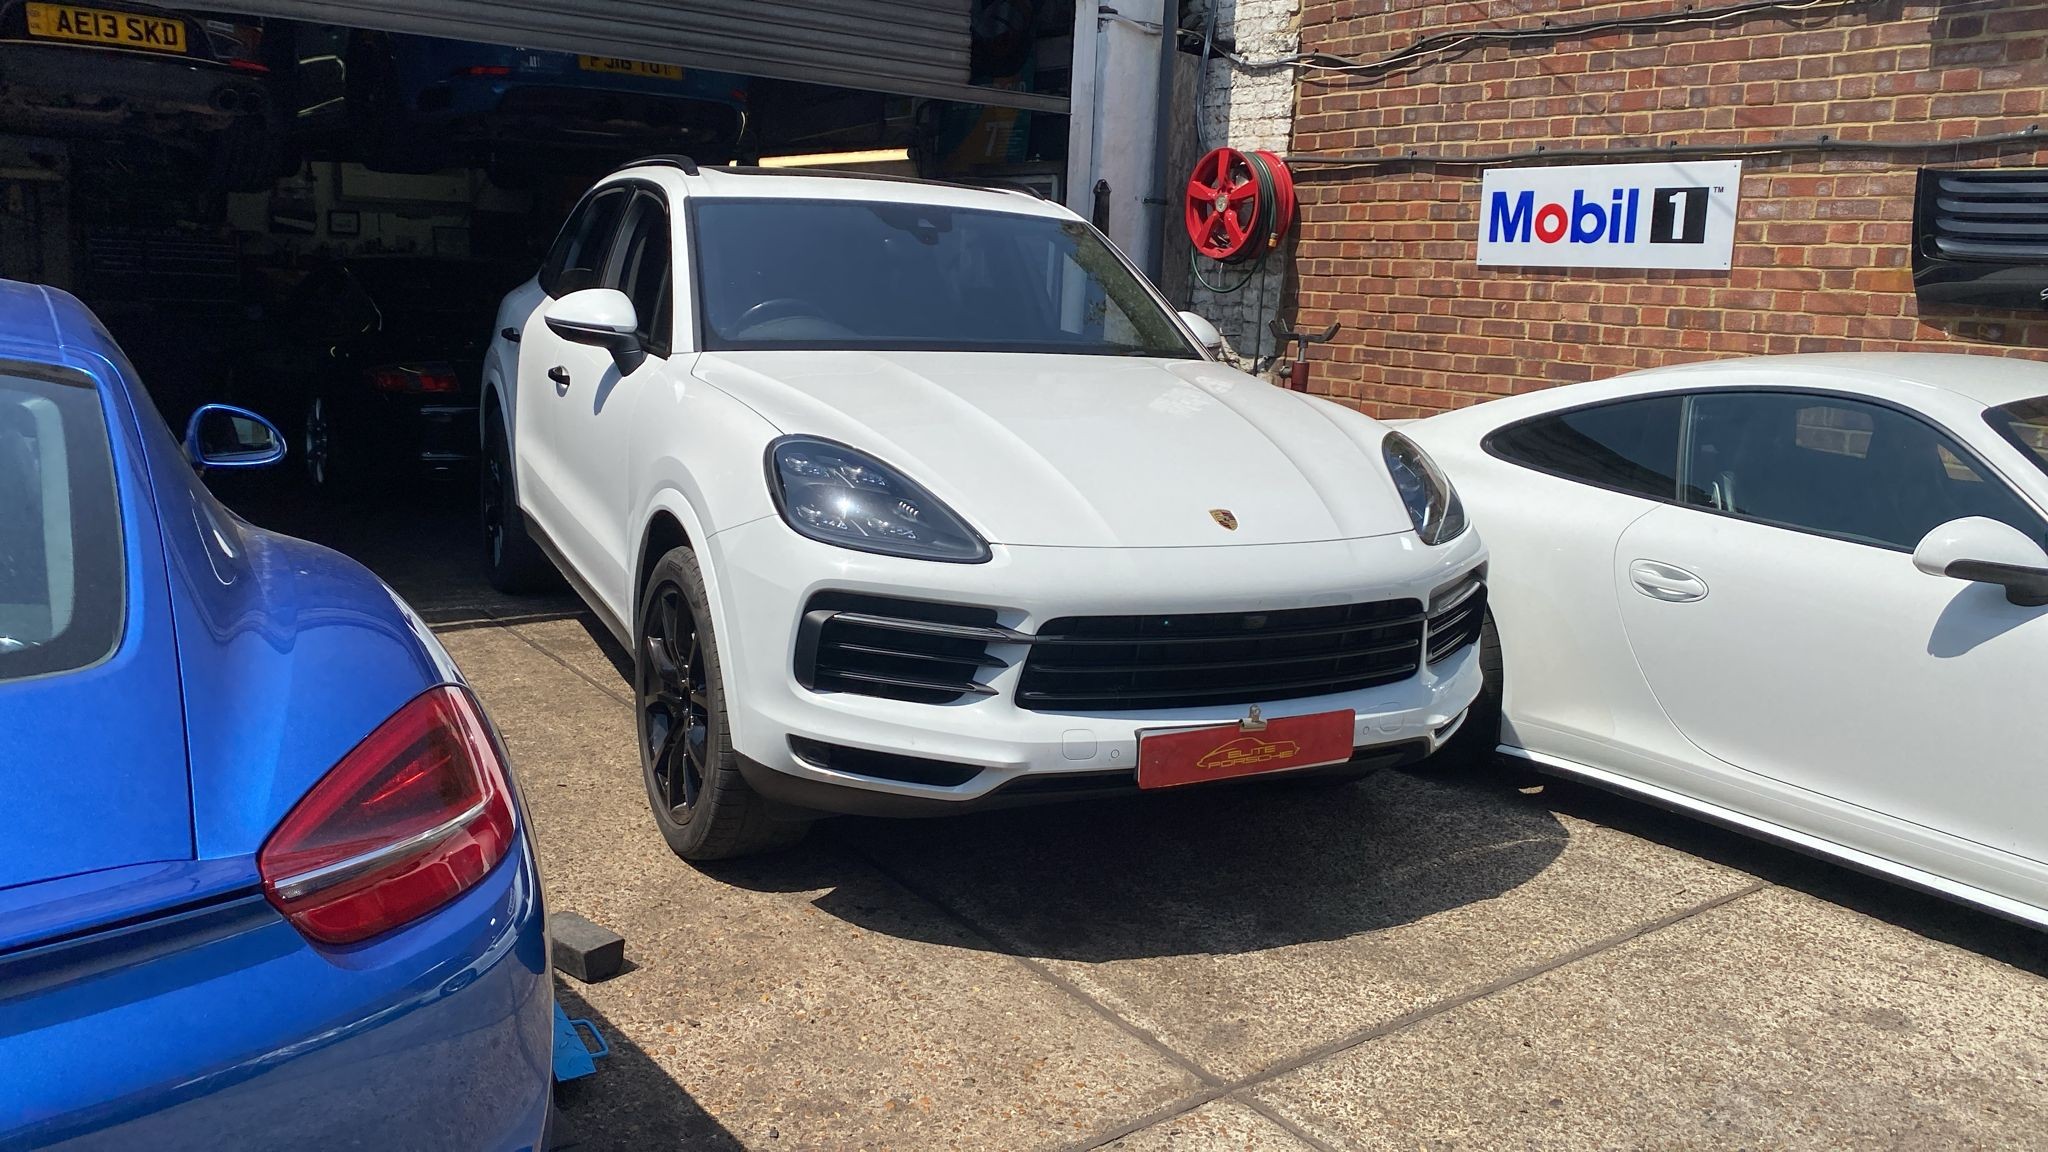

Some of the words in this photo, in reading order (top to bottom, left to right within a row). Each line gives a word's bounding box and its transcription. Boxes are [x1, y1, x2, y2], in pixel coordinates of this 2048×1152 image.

[56, 10, 119, 39] AE13
[126, 17, 178, 46] SKD
[1488, 188, 1640, 244] Mobil
[1668, 191, 1688, 240] 1
[1208, 750, 1295, 769] PORSCHE
[1227, 744, 1276, 760] ELITE
